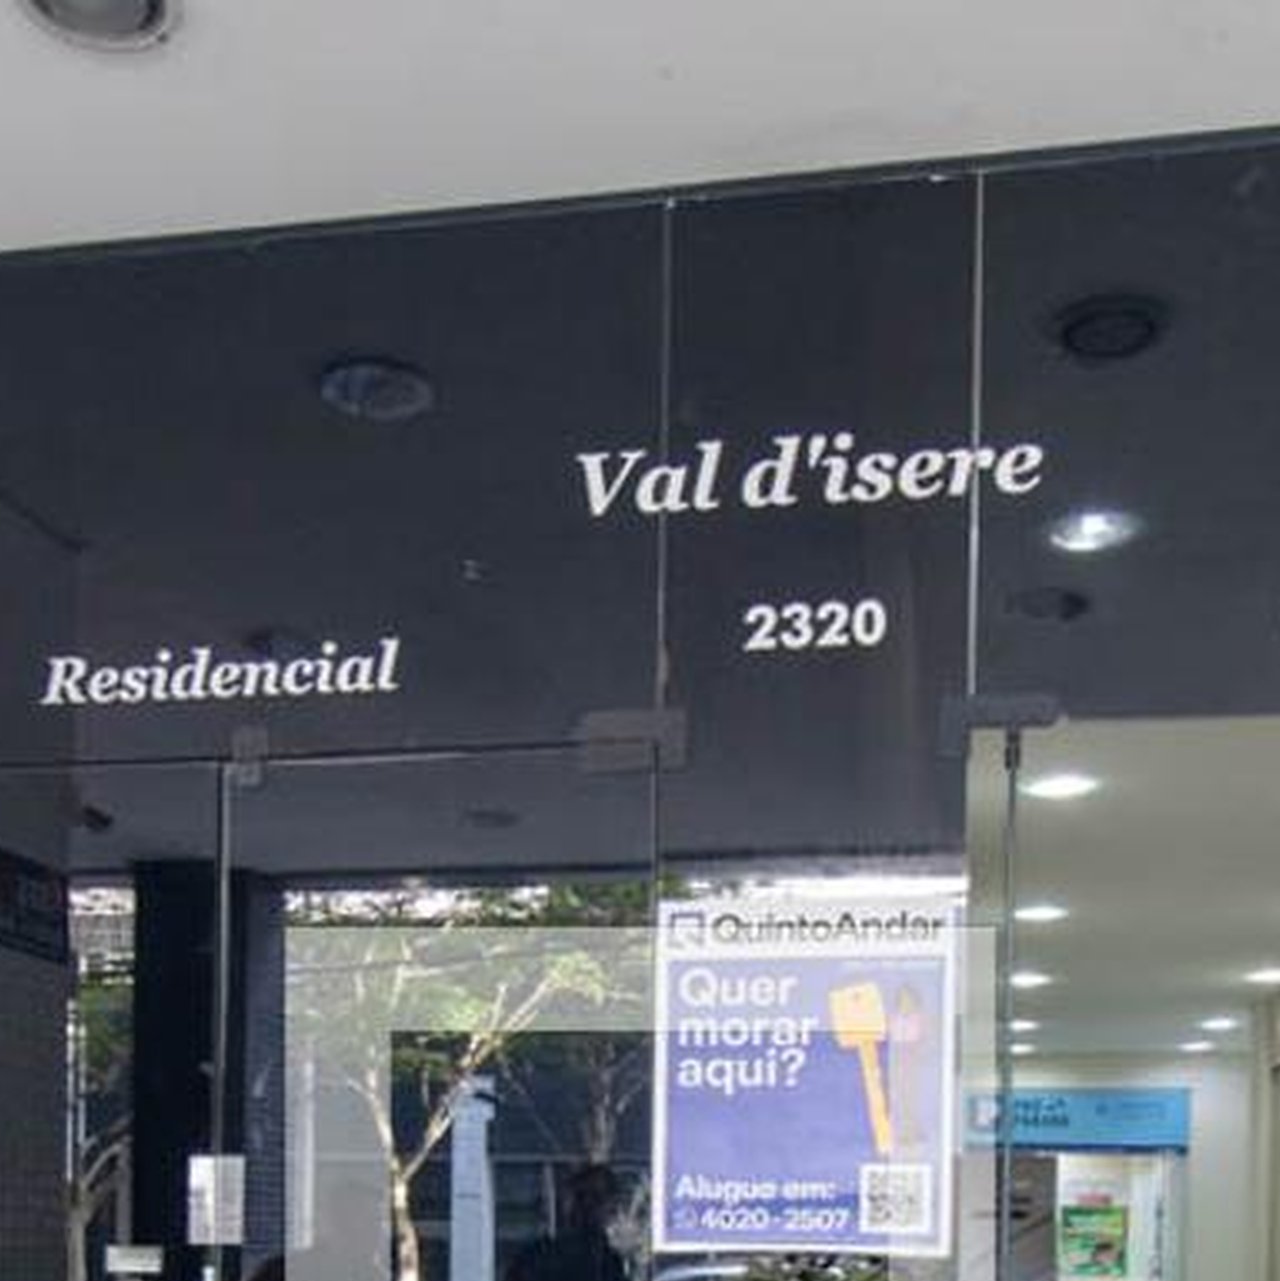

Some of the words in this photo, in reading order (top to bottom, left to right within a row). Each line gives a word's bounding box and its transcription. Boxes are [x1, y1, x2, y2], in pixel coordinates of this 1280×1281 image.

[576, 439, 723, 516] Val
[740, 432, 1044, 508] d'isere
[742, 599, 888, 651] 2320
[40, 636, 401, 705] Residencial
[712, 910, 946, 942] QuintoAndar
[677, 966, 800, 1009] Quer
[677, 1014, 820, 1047] morar
[676, 1047, 807, 1096] aqui?
[675, 1174, 778, 1207] Alugue
[782, 1181, 837, 1200] em:
